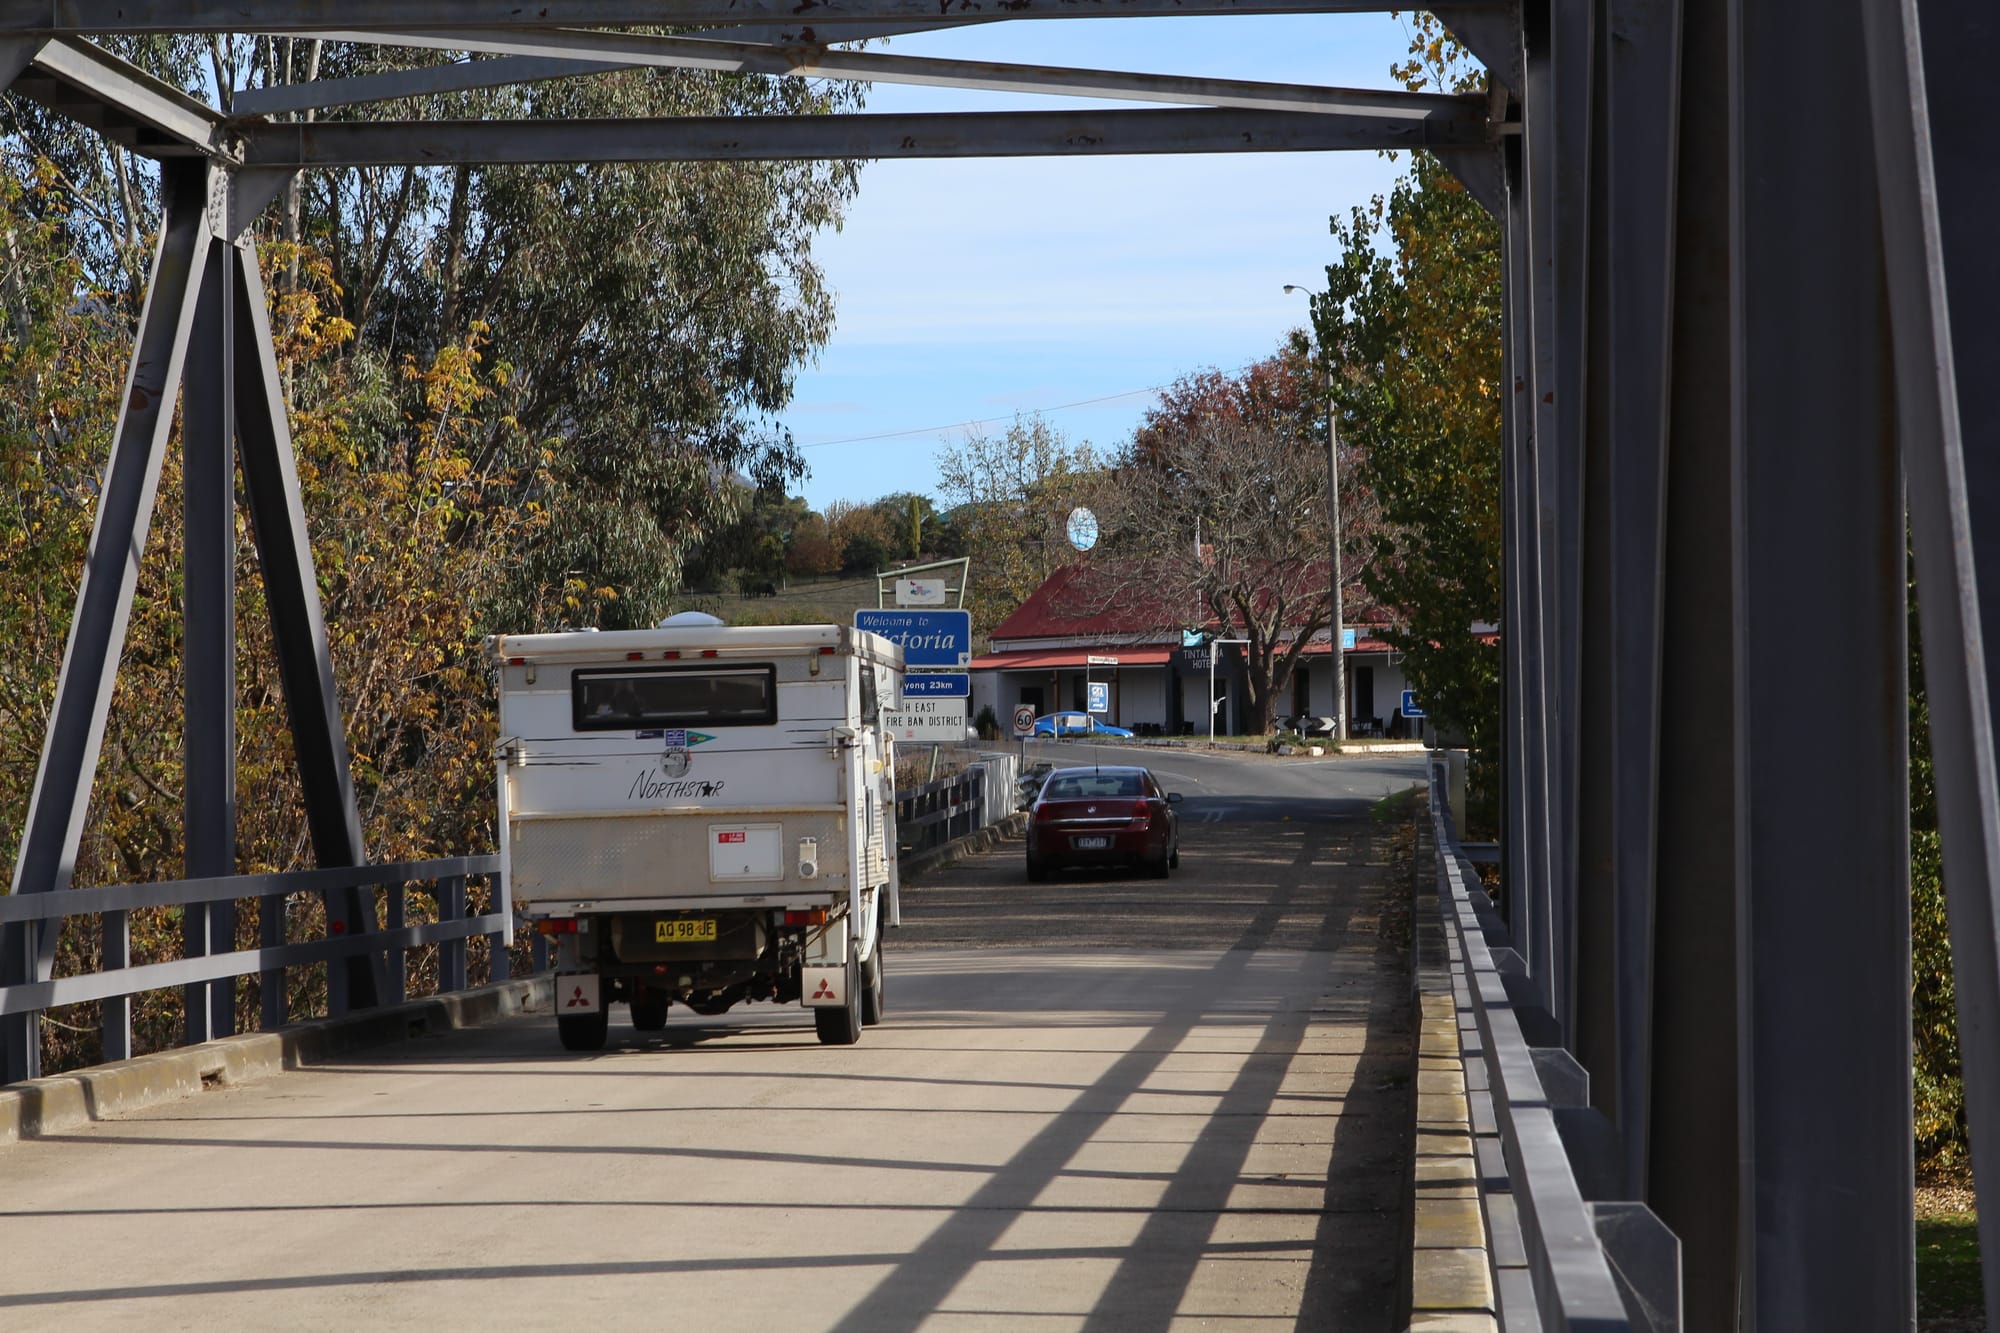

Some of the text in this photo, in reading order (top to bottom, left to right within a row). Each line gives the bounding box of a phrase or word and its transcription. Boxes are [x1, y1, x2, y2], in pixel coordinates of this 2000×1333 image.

[863, 616, 929, 626] Welcome to
[864, 629, 955, 649] ictoria
[1183, 649, 1224, 659] TINTALA
[1193, 659, 1213, 669] HOTE
[904, 681, 953, 691] yong 23km
[915, 702, 936, 713] EAST
[886, 715, 963, 727] FIRE BAN DISTRICT
[1017, 714, 1032, 726] 60
[678, 922, 694, 937] 98
